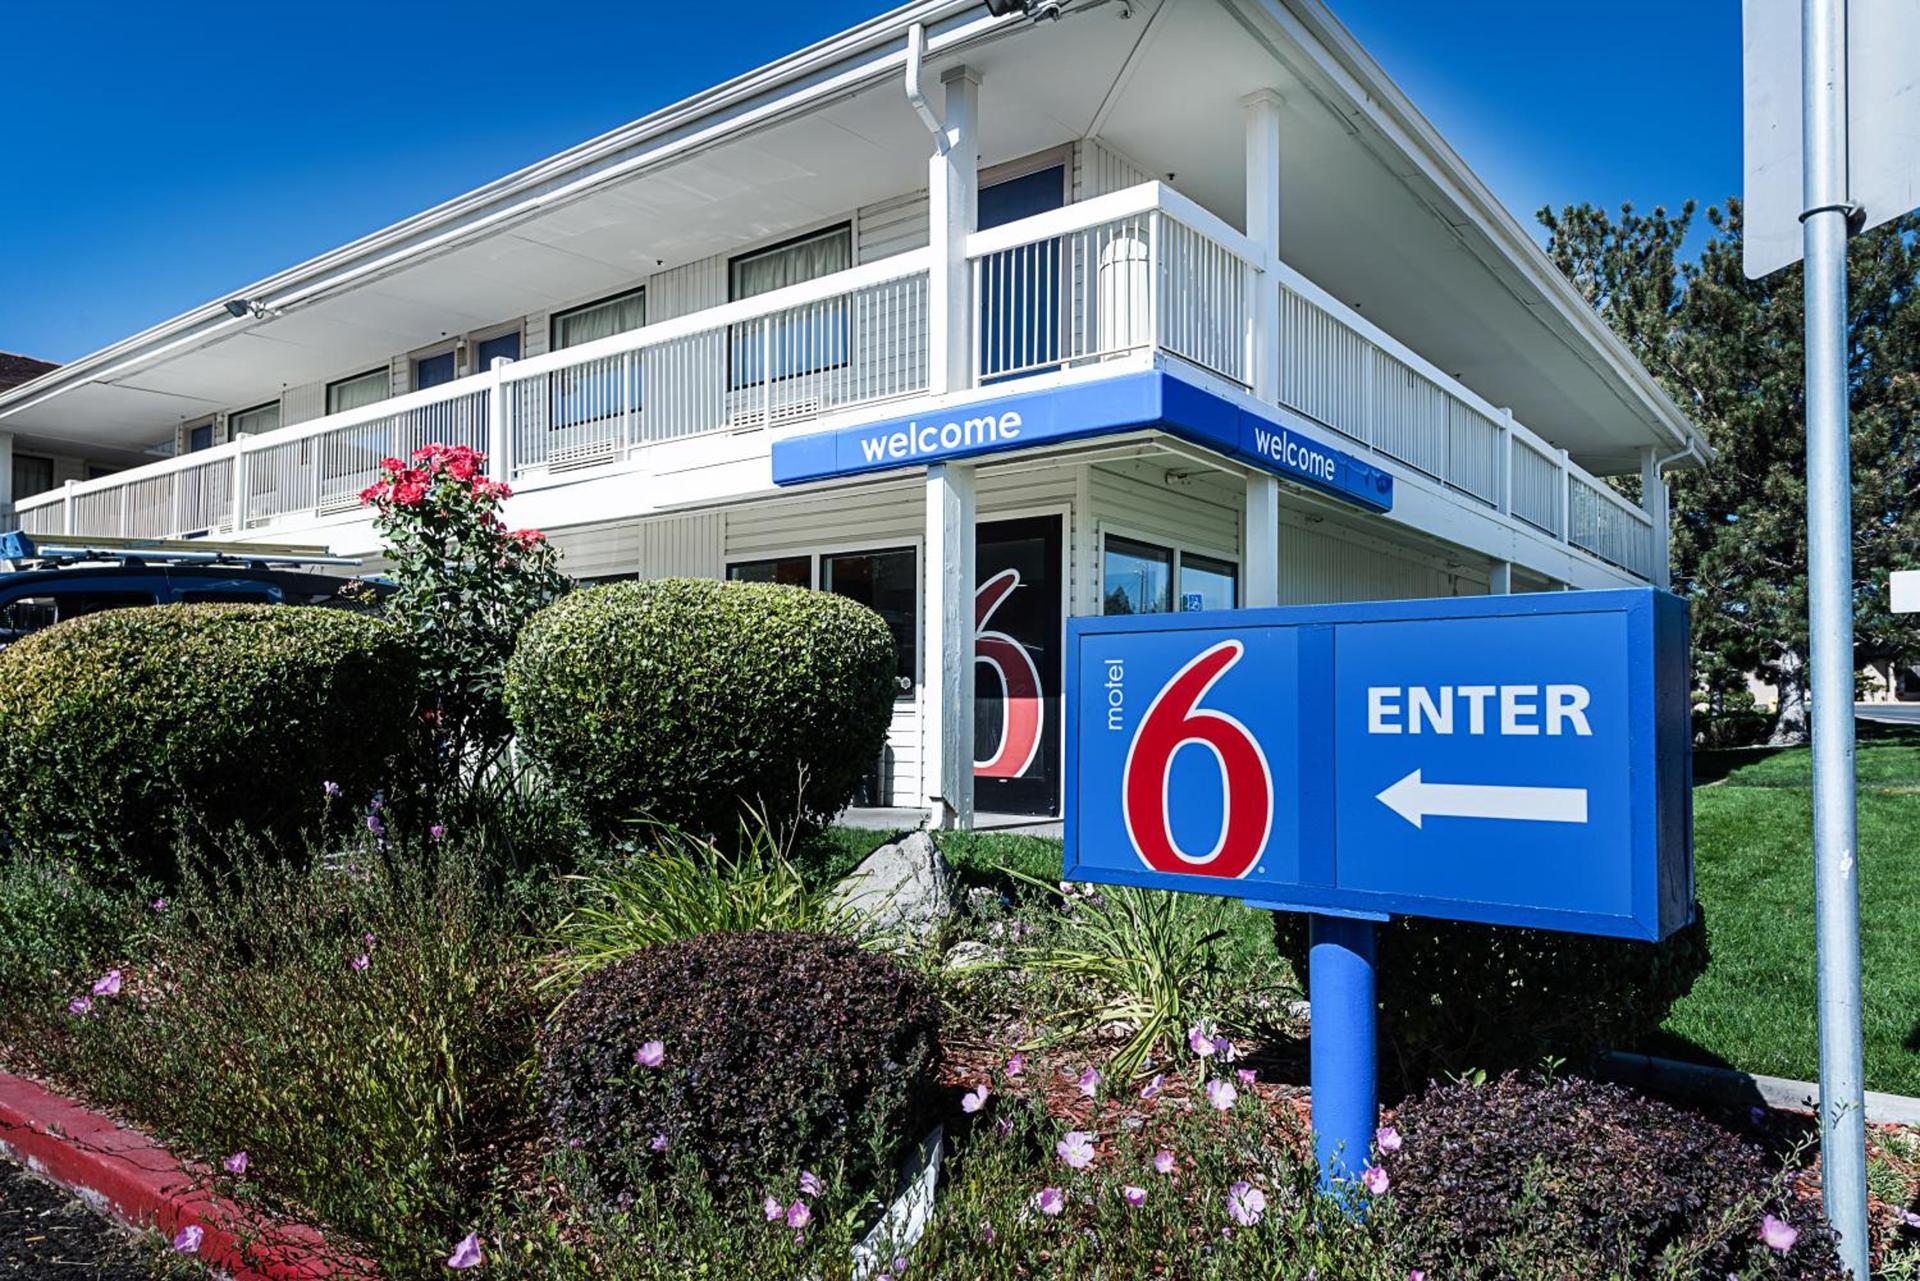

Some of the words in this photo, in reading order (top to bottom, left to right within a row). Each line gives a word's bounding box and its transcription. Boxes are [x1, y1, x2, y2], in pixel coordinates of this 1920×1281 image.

[861, 410, 1021, 461] welcome
[1255, 427, 1335, 481] welcome
[1367, 684, 1592, 737] ENTER
[1105, 659, 1124, 731] motel
[1122, 639, 1274, 880] 6
